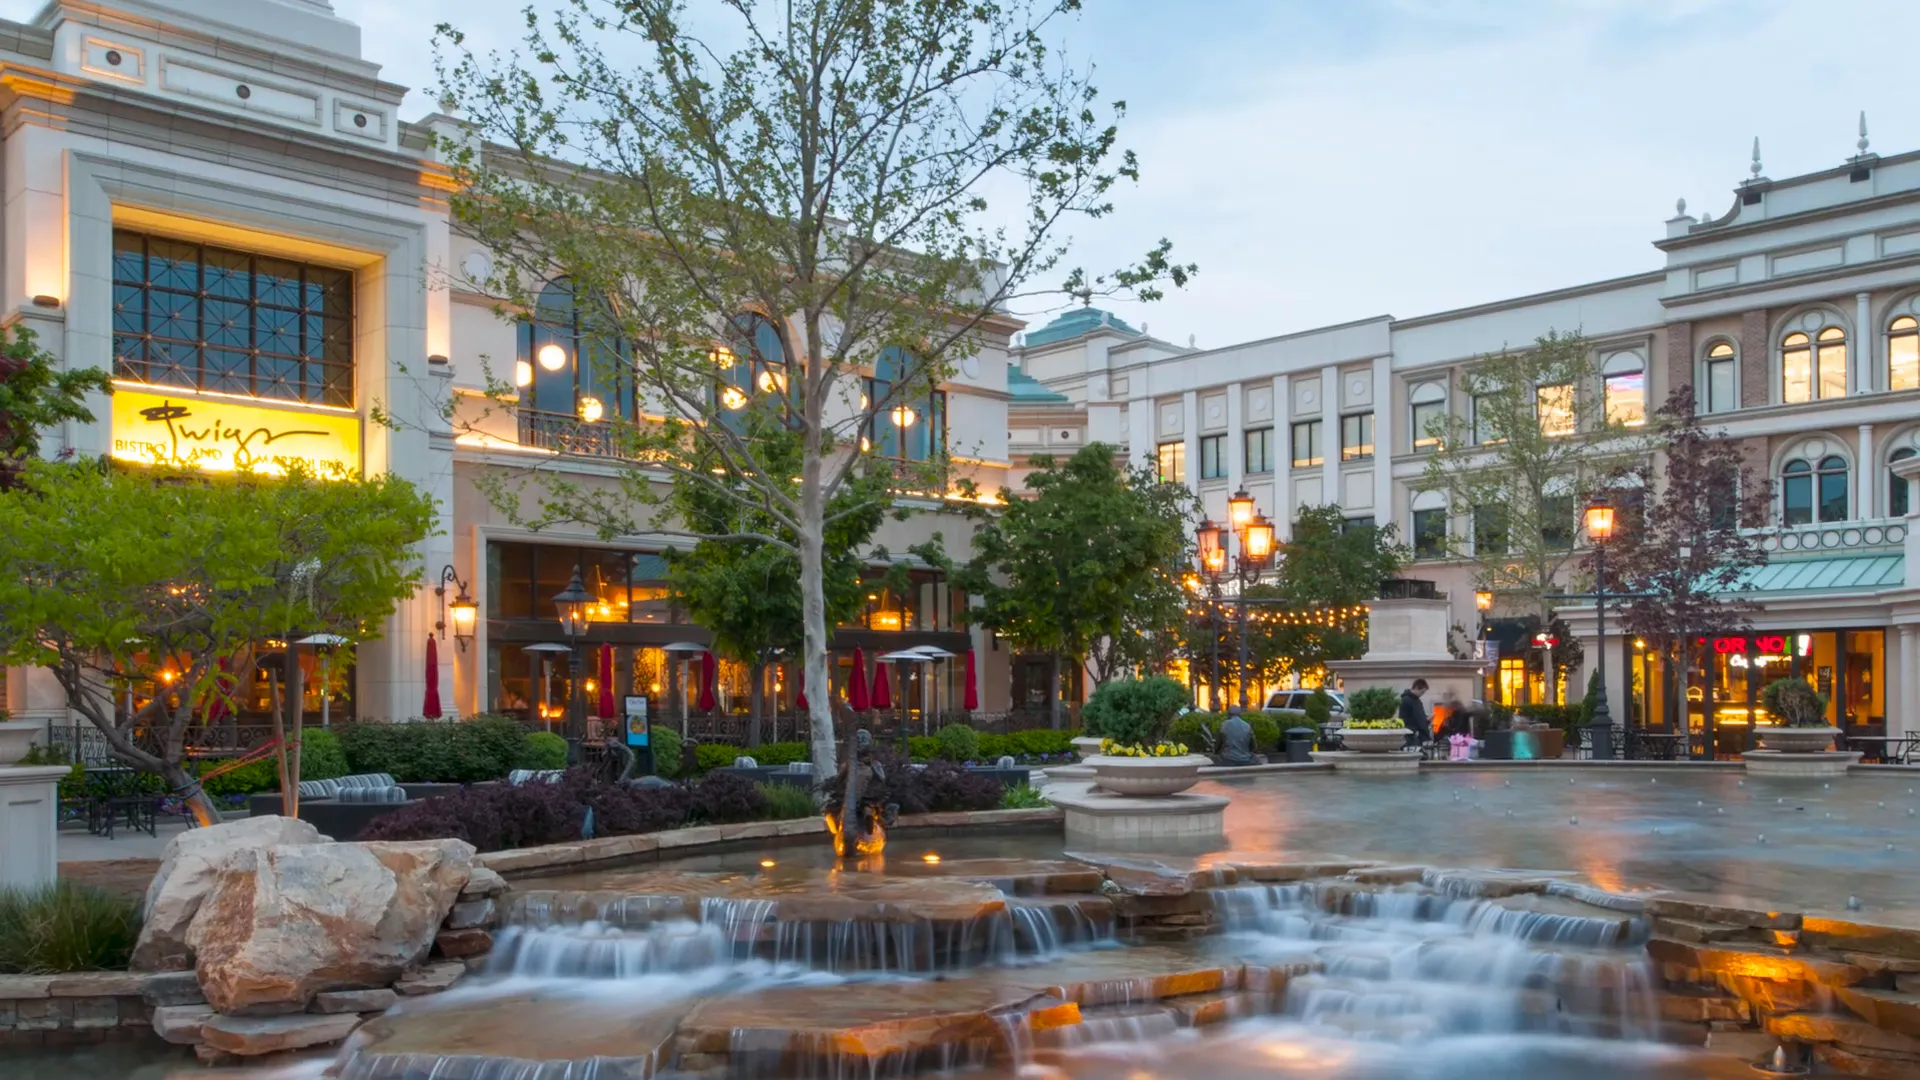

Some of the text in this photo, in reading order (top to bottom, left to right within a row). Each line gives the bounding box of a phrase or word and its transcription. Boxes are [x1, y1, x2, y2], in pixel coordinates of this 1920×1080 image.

[115, 439, 166, 454] BISTRO
[190, 447, 222, 461] AND
[139, 400, 330, 464] Twigs
